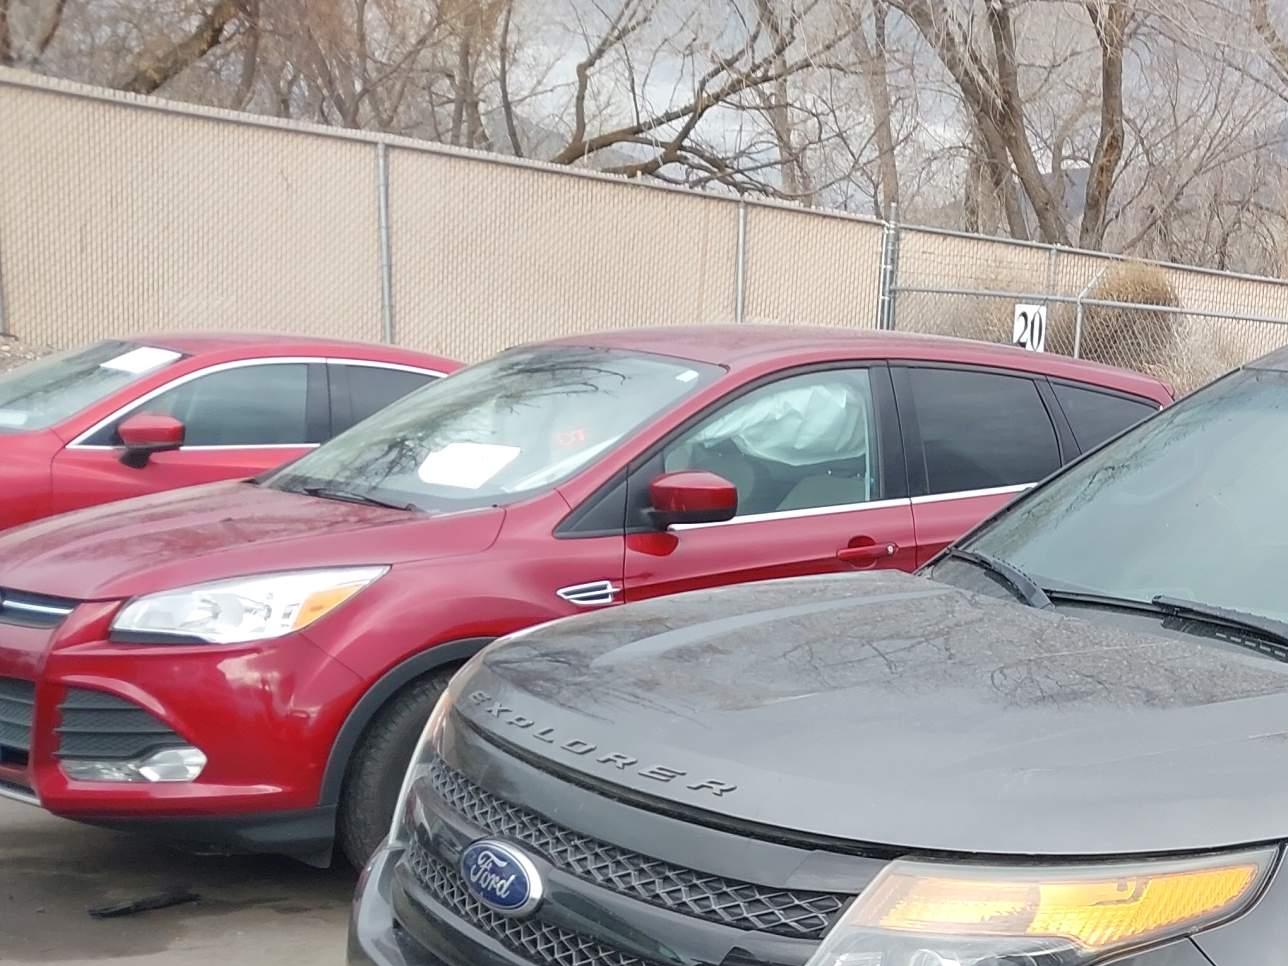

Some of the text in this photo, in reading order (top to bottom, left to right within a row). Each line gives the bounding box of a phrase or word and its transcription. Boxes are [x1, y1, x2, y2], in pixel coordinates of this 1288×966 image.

[1017, 310, 1043, 352] 20
[469, 690, 738, 797] EXPLORER
[470, 850, 516, 899] Ford
